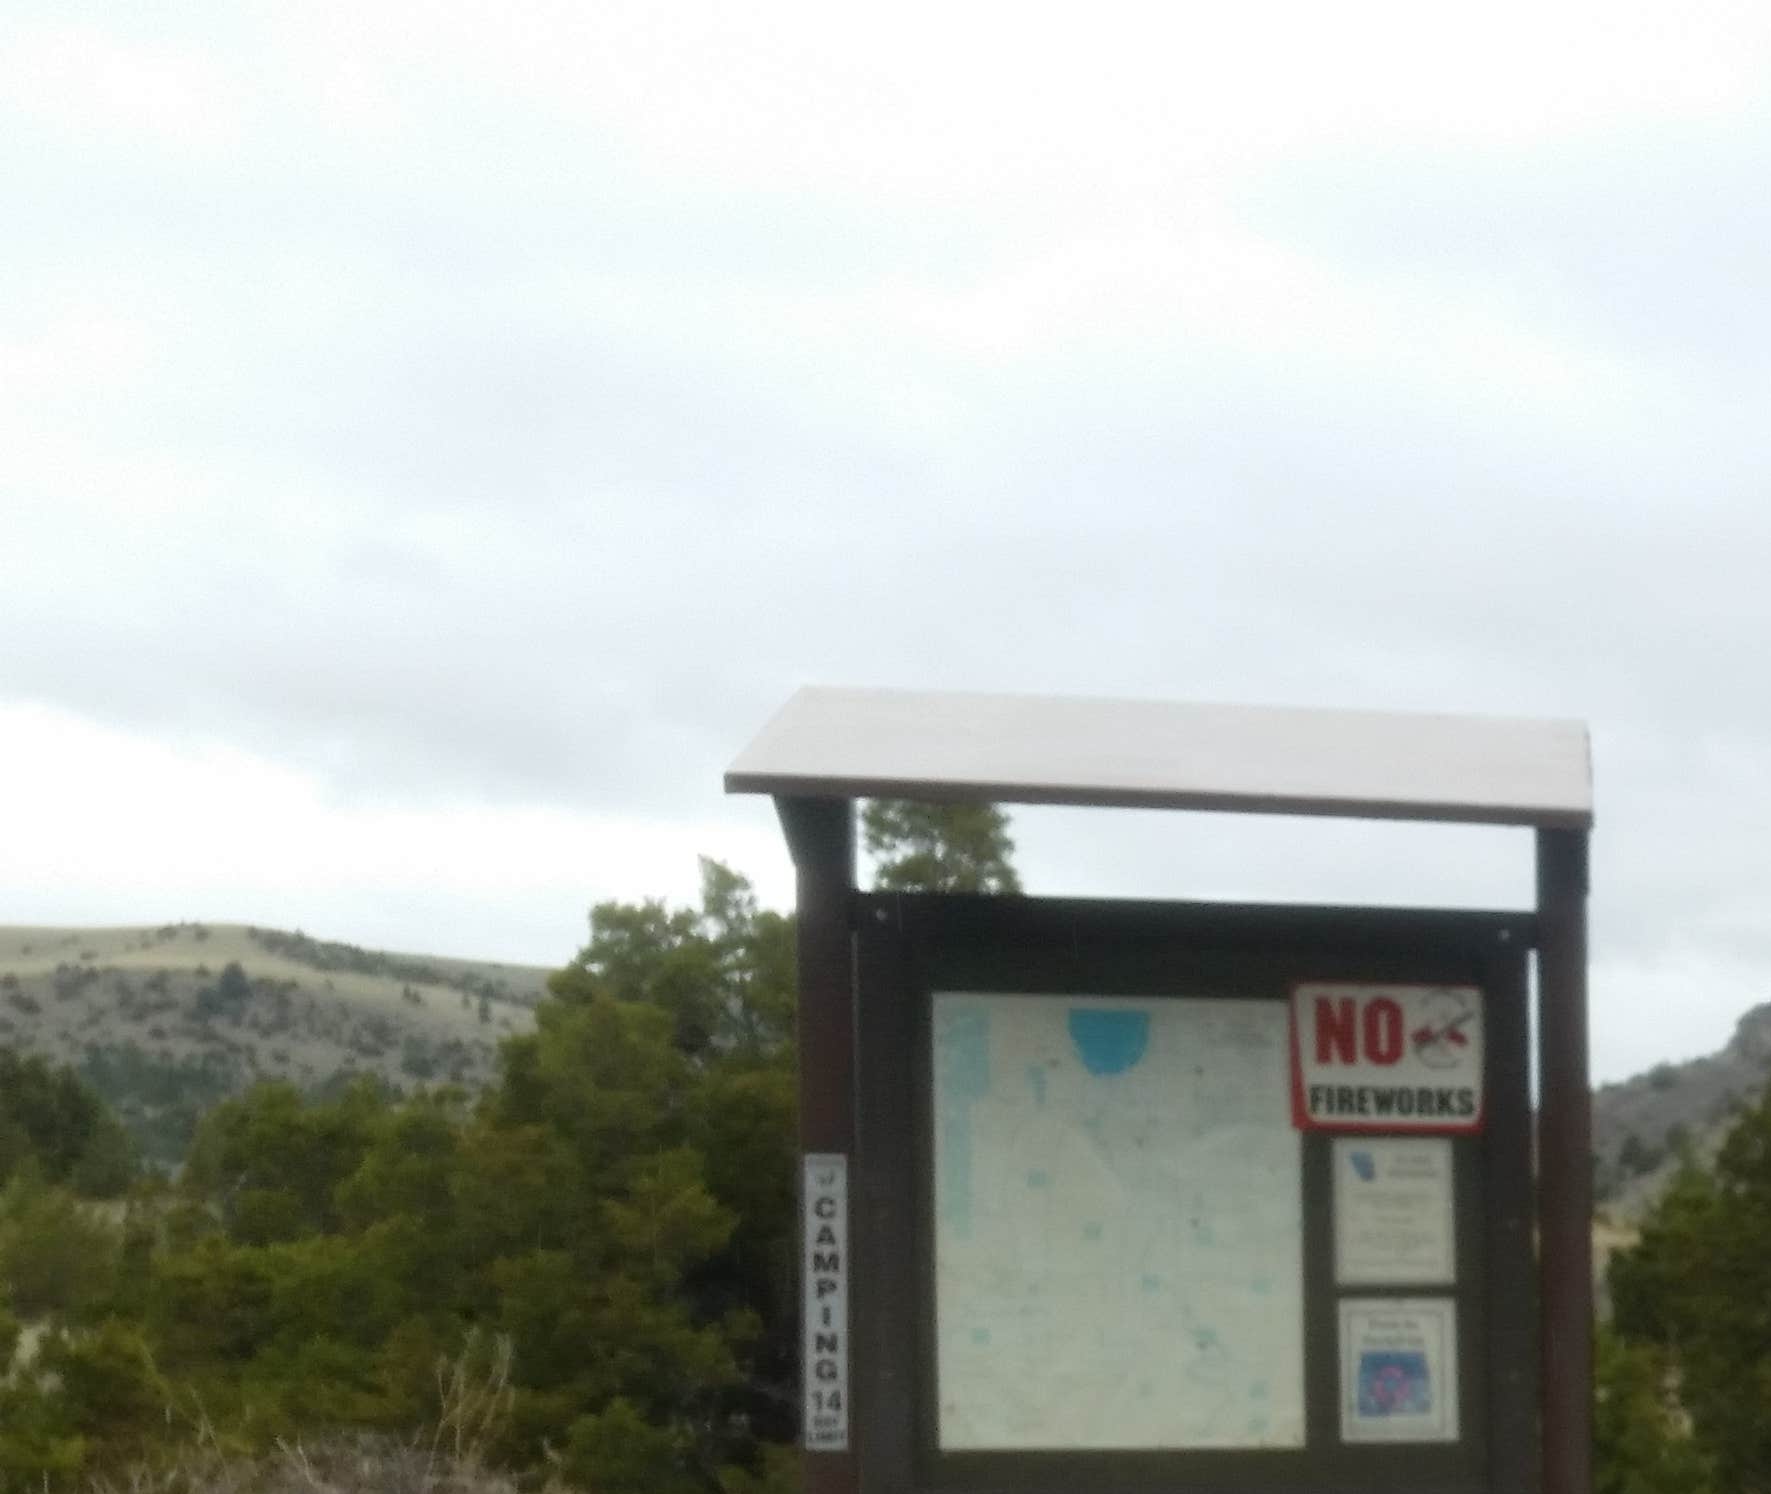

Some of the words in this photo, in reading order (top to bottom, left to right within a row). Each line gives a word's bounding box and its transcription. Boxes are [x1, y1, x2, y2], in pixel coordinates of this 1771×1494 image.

[1315, 997, 1402, 1066] NO
[1310, 1085, 1474, 1116] FIREWORKS
[813, 1197, 840, 1381] CAMPING
[812, 1389, 842, 1411] 14
